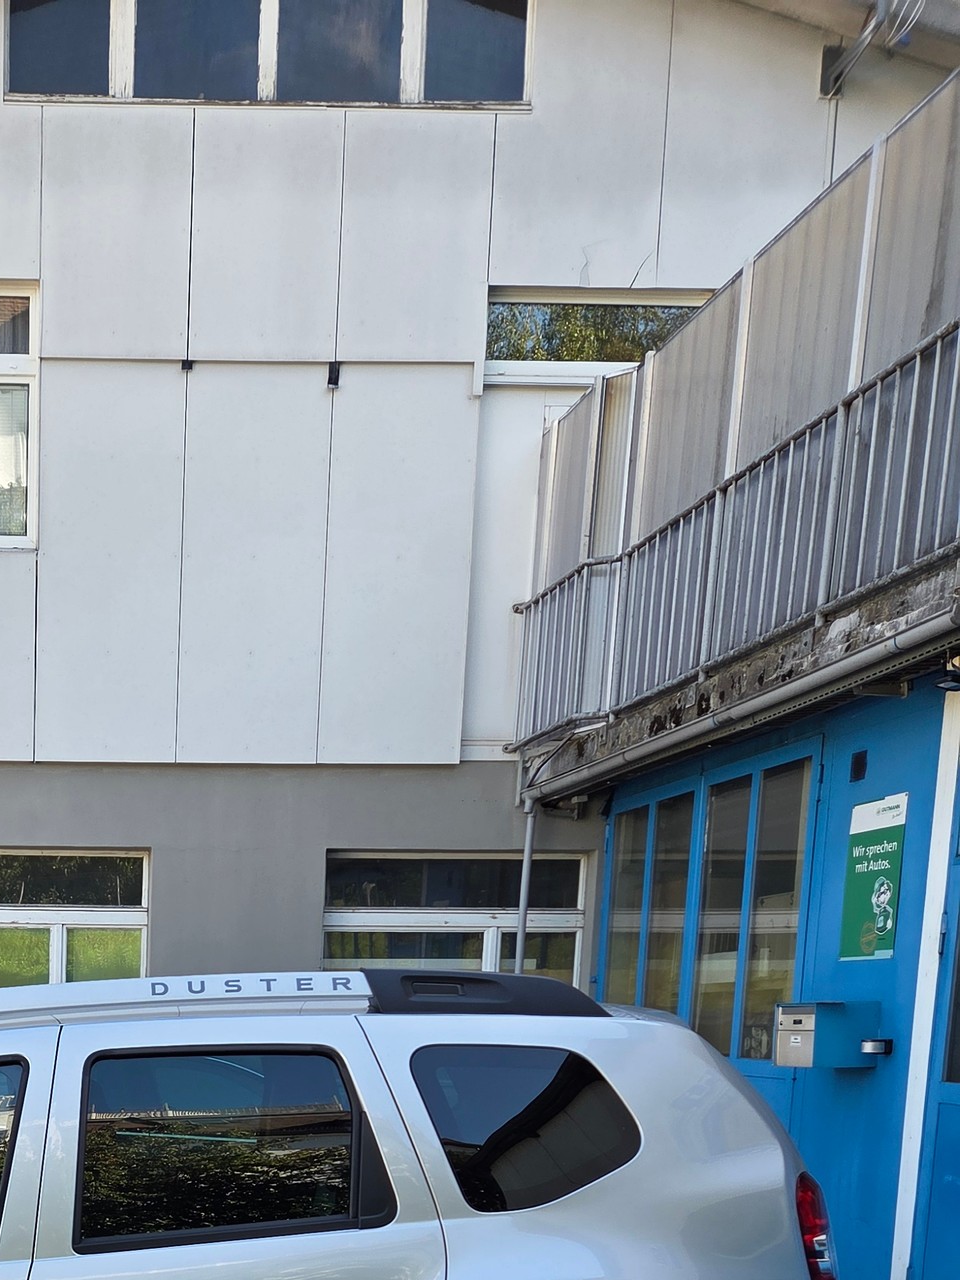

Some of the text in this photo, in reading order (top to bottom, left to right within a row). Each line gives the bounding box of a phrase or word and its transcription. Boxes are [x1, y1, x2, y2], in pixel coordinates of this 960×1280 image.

[852, 840, 898, 858] Wir sprechen
[855, 859, 891, 873] mit Autos.
[150, 976, 353, 996] DUSTER
